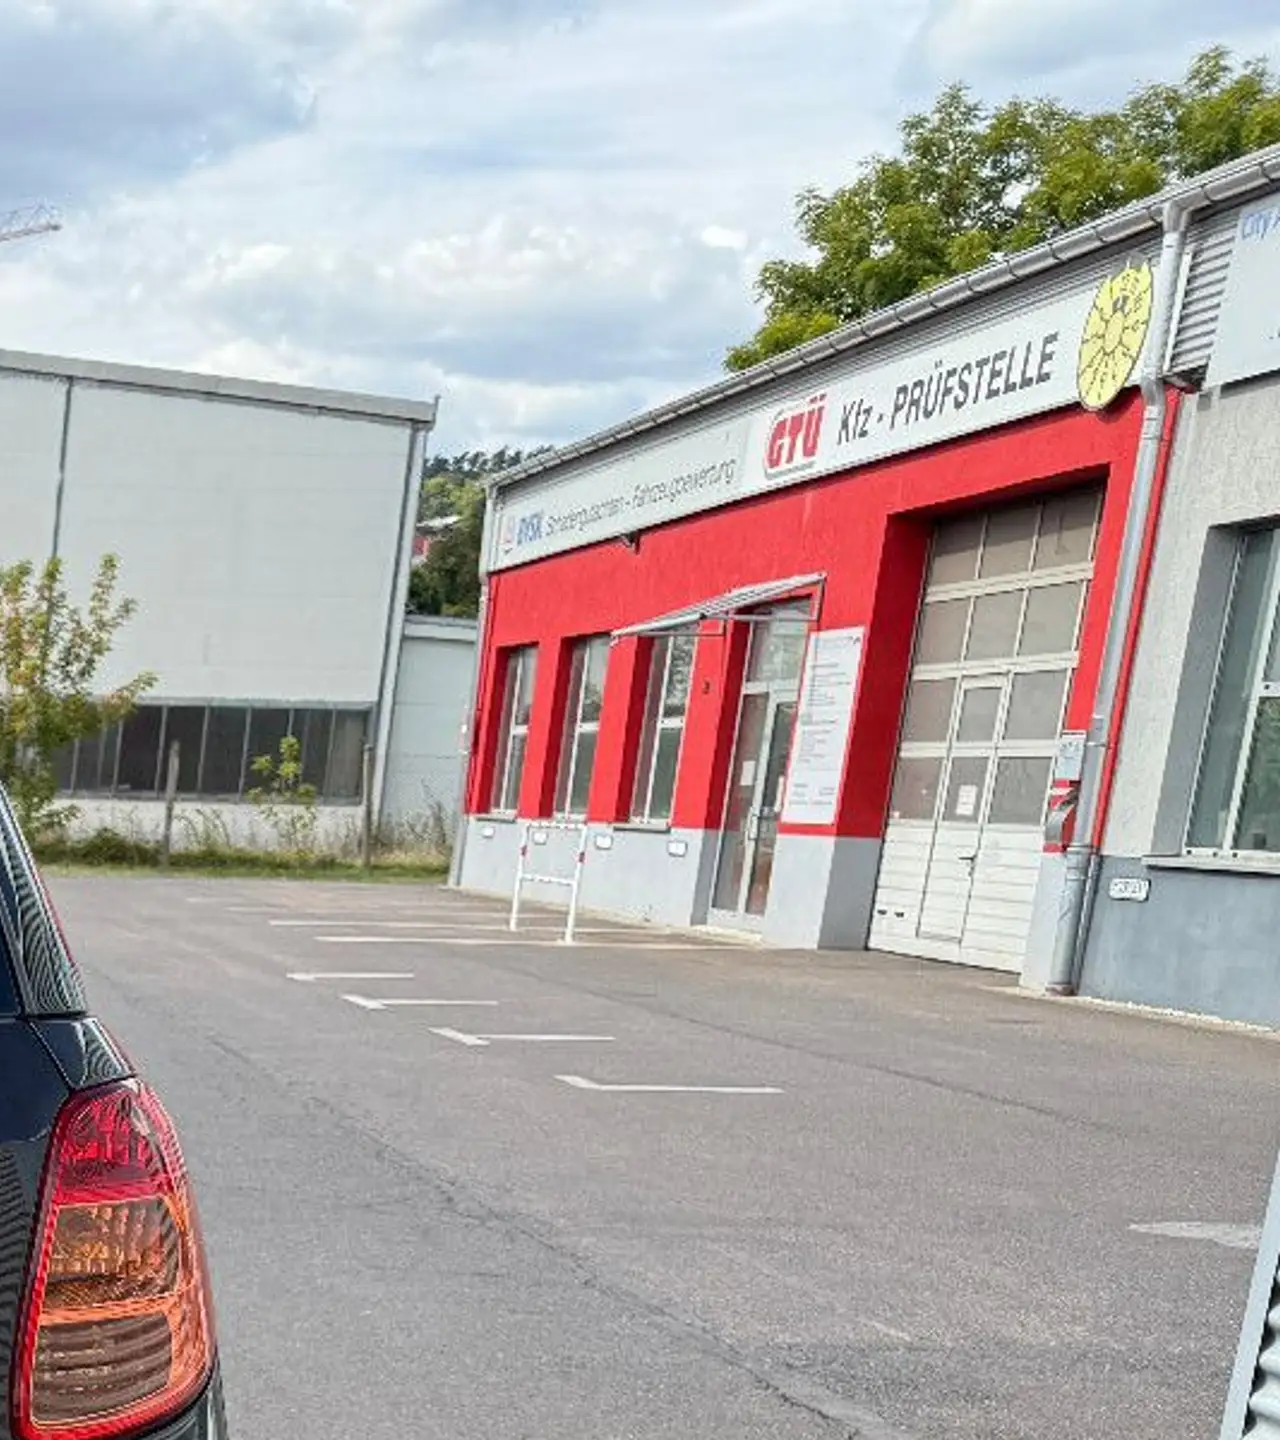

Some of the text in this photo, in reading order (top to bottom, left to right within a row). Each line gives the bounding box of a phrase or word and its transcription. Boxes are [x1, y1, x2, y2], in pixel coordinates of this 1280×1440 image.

[767, 392, 827, 469] GTÜ
[837, 398, 874, 445] Kfz
[889, 331, 1059, 430] PRÜFSTELLE
